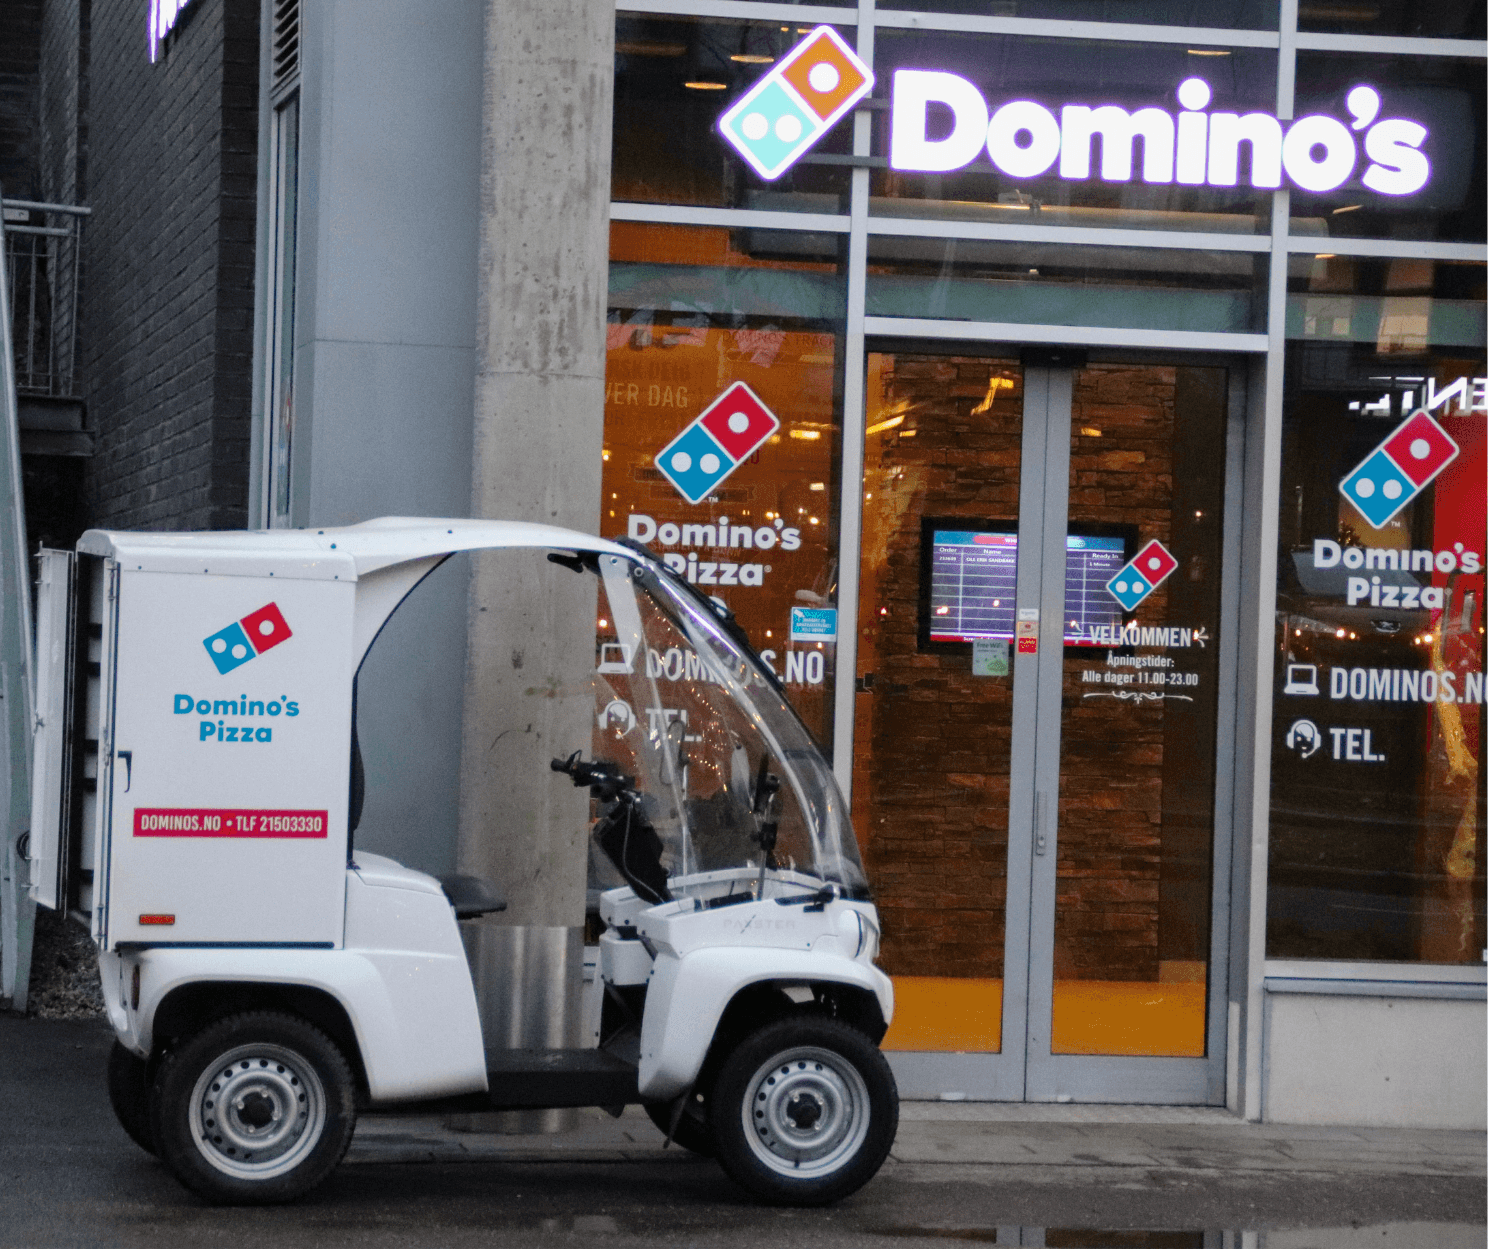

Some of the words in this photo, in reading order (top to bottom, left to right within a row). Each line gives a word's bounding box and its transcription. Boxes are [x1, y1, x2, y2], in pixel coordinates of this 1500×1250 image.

[889, 69, 1431, 196] Domino's
[648, 385, 688, 409] DAG
[627, 514, 801, 551] Domino's
[1092, 552, 1110, 560] Ready
[1313, 538, 1480, 574] Domino's
[663, 552, 764, 587] Pizza
[1347, 575, 1444, 609] Pizza
[1089, 625, 1192, 647] VELKOMMEN
[1107, 650, 1175, 669] Åpningstider:
[1082, 670, 1101, 683] Alle
[1104, 671, 1134, 686] dager
[1137, 671, 1199, 686] 11.00-23.00
[173, 693, 300, 717] Domino's
[199, 719, 272, 743] Pizza
[1329, 727, 1386, 761] TEL.
[140, 814, 221, 831] DOMINOS.NO
[236, 815, 258, 832] TLF
[259, 816, 322, 832] 21503330
